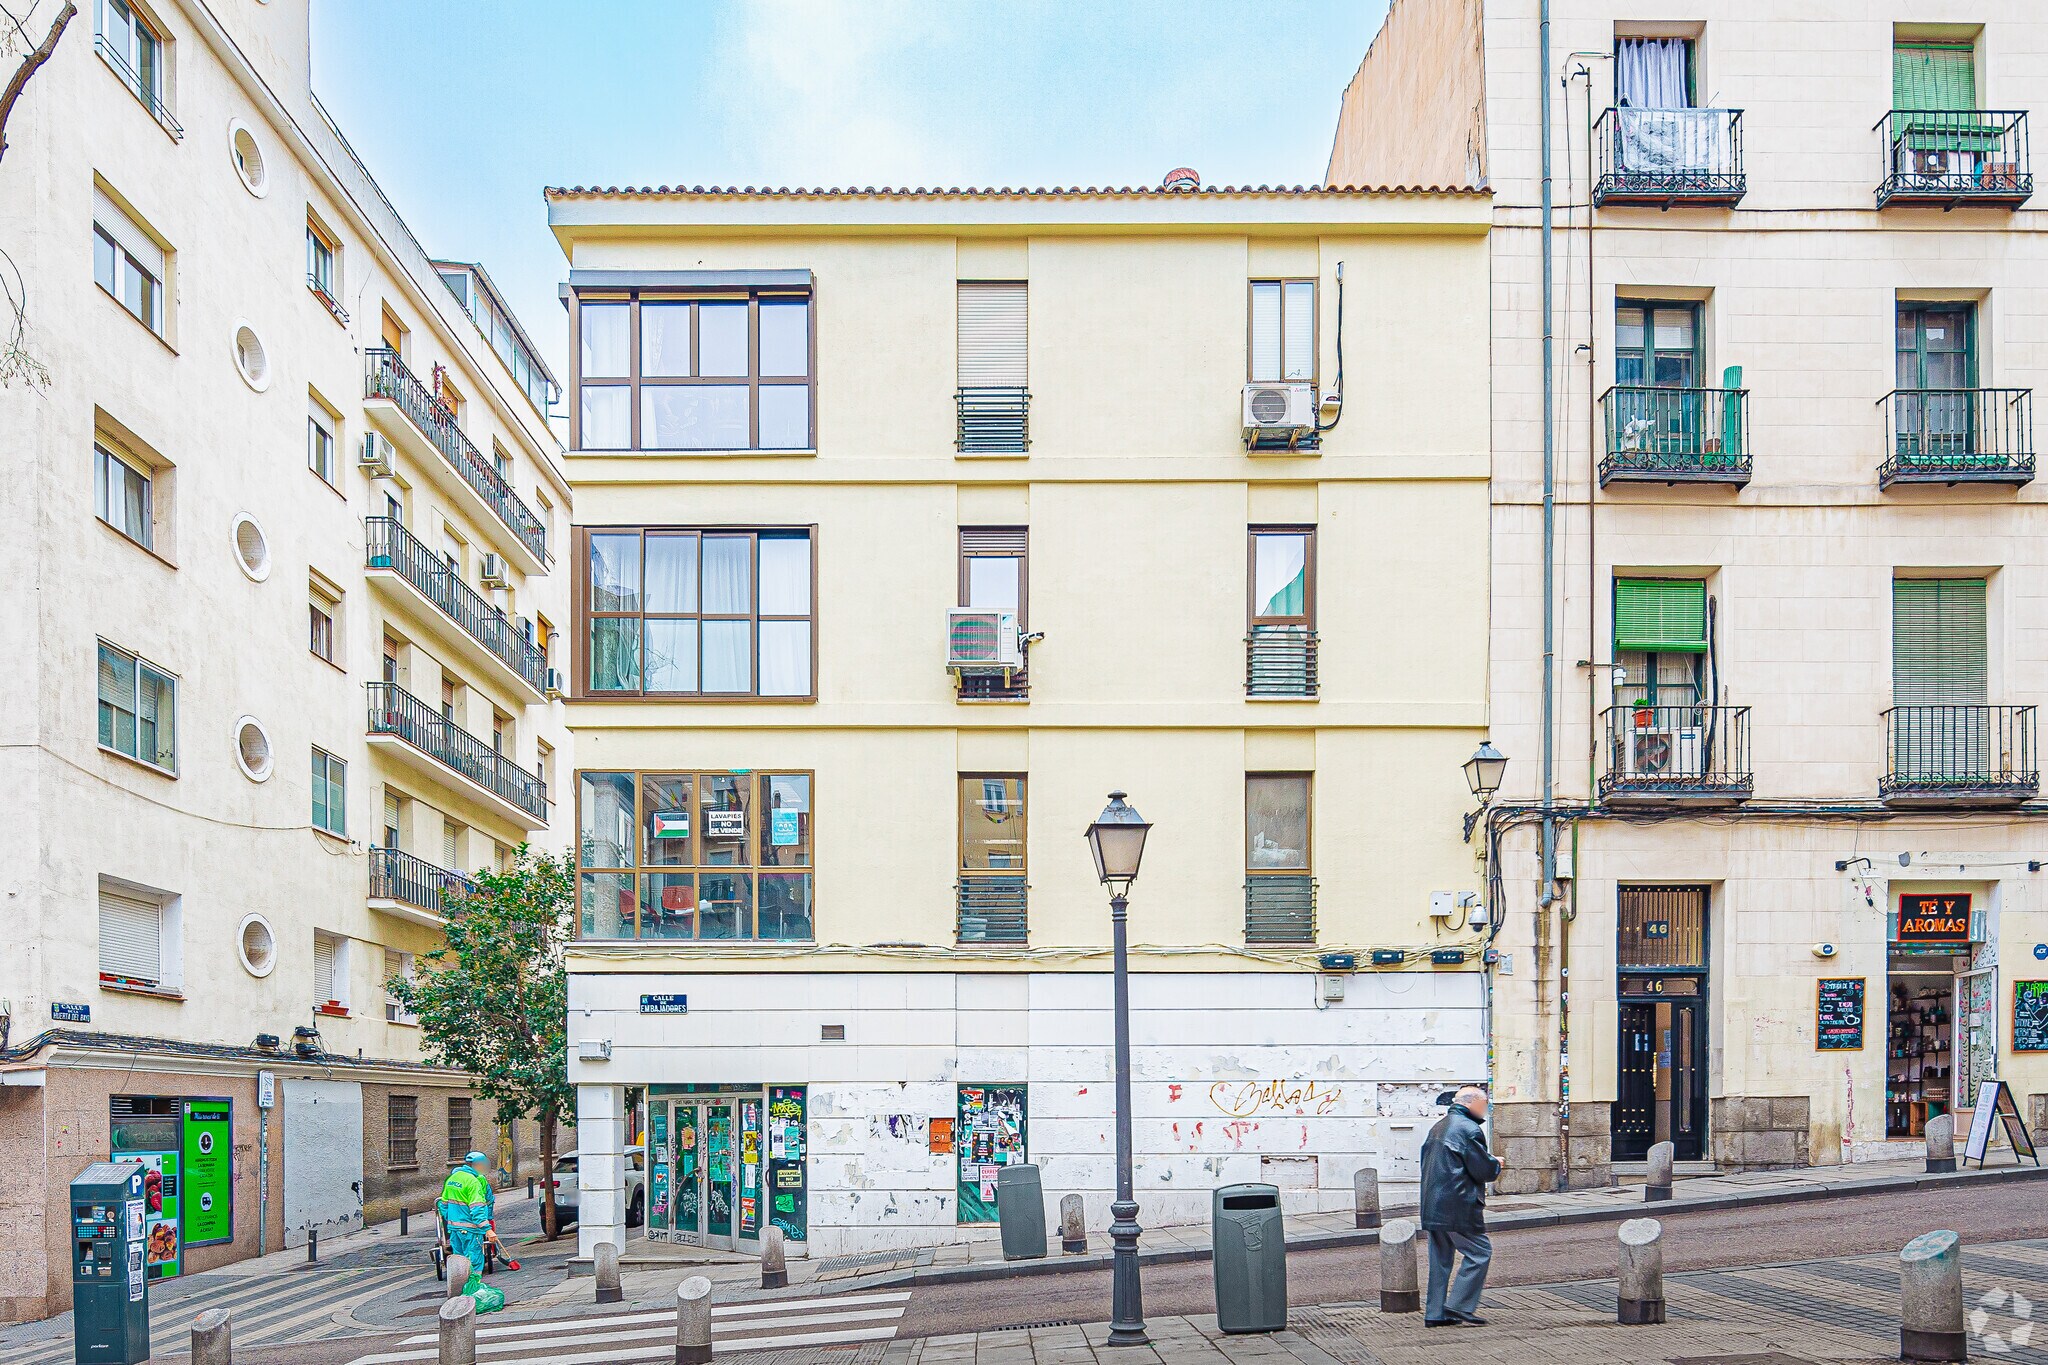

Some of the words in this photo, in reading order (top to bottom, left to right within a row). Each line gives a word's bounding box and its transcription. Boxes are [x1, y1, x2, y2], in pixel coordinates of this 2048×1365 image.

[1919, 898, 1938, 915] TÉ
[1944, 900, 1956, 915] Y
[1649, 924, 1667, 934] 46
[1902, 918, 1966, 932] AROMAS
[1646, 980, 1663, 992] 46
[640, 1004, 687, 1013] EMBAJADORES
[132, 1174, 142, 1194] P
